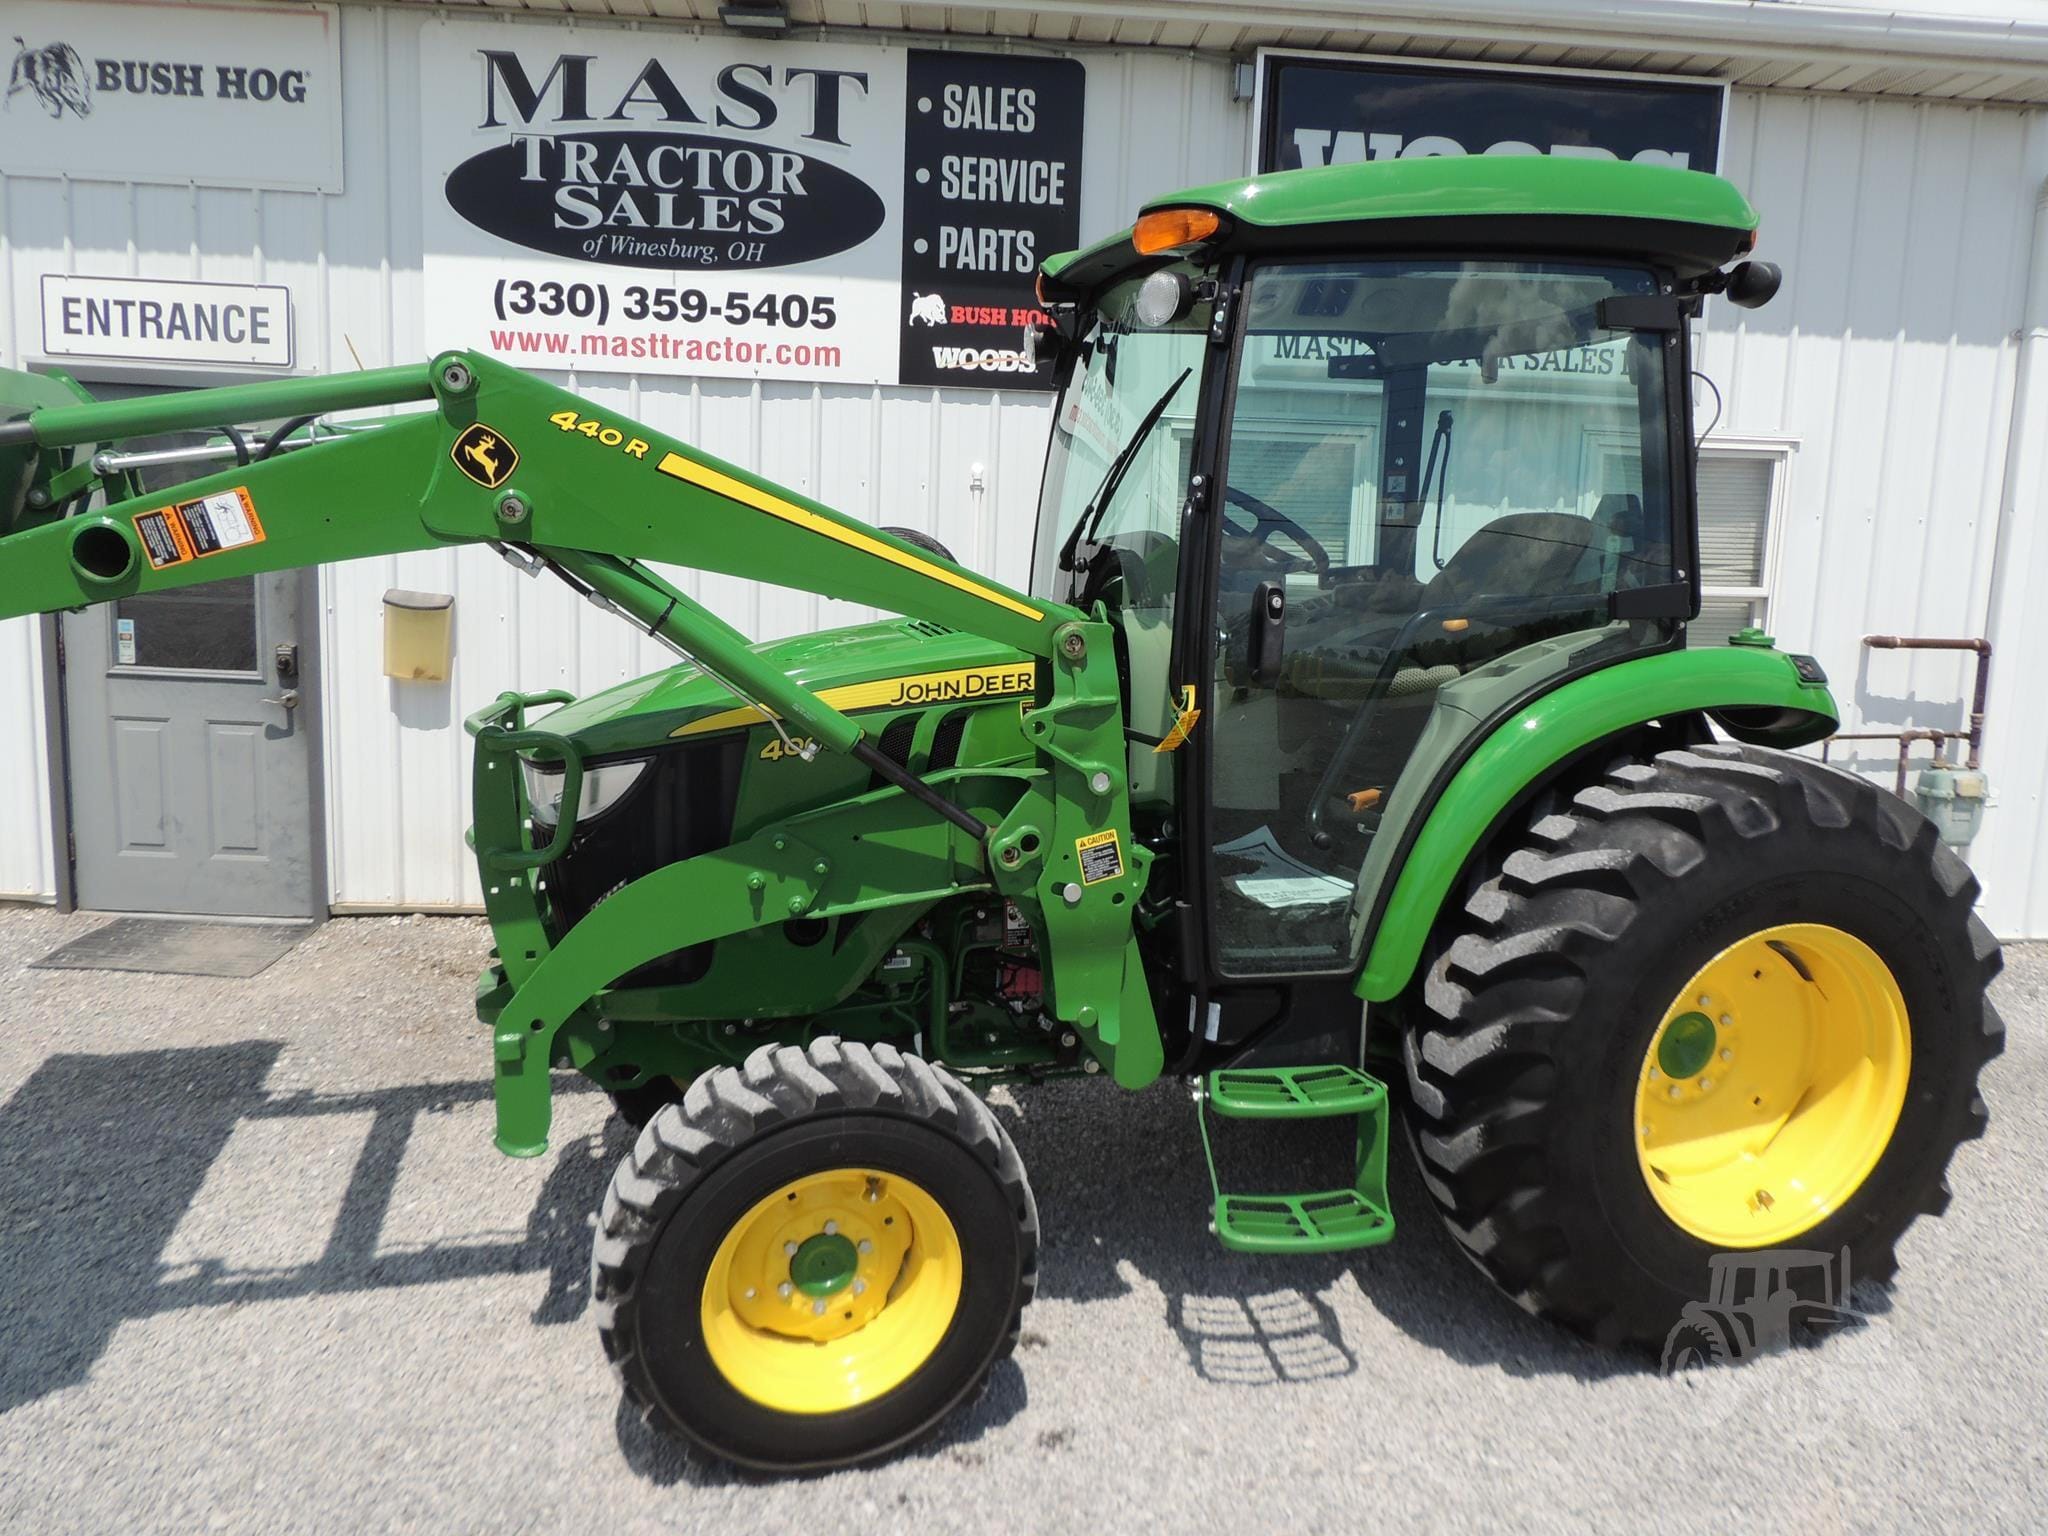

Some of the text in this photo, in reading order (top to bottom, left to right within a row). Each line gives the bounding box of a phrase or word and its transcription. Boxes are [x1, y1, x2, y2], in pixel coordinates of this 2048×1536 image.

[95, 59, 307, 103] BUSH HOG
[477, 49, 869, 147] MAST
[943, 84, 1036, 133] SALES
[511, 133, 808, 196] TRACTOR
[941, 155, 1066, 205] SERVICE
[554, 185, 785, 235] SALES
[582, 235, 766, 263] of Winesburg, OH
[938, 226, 1036, 273] PARTS
[62, 296, 271, 344] ENTRANCE
[493, 279, 838, 330] (330) 359-5405
[951, 306, 1007, 326] BUSH
[490, 330, 841, 367] www.masttractor.com
[890, 681, 960, 703] JOHN
[1087, 831, 1115, 845] CAUTION
